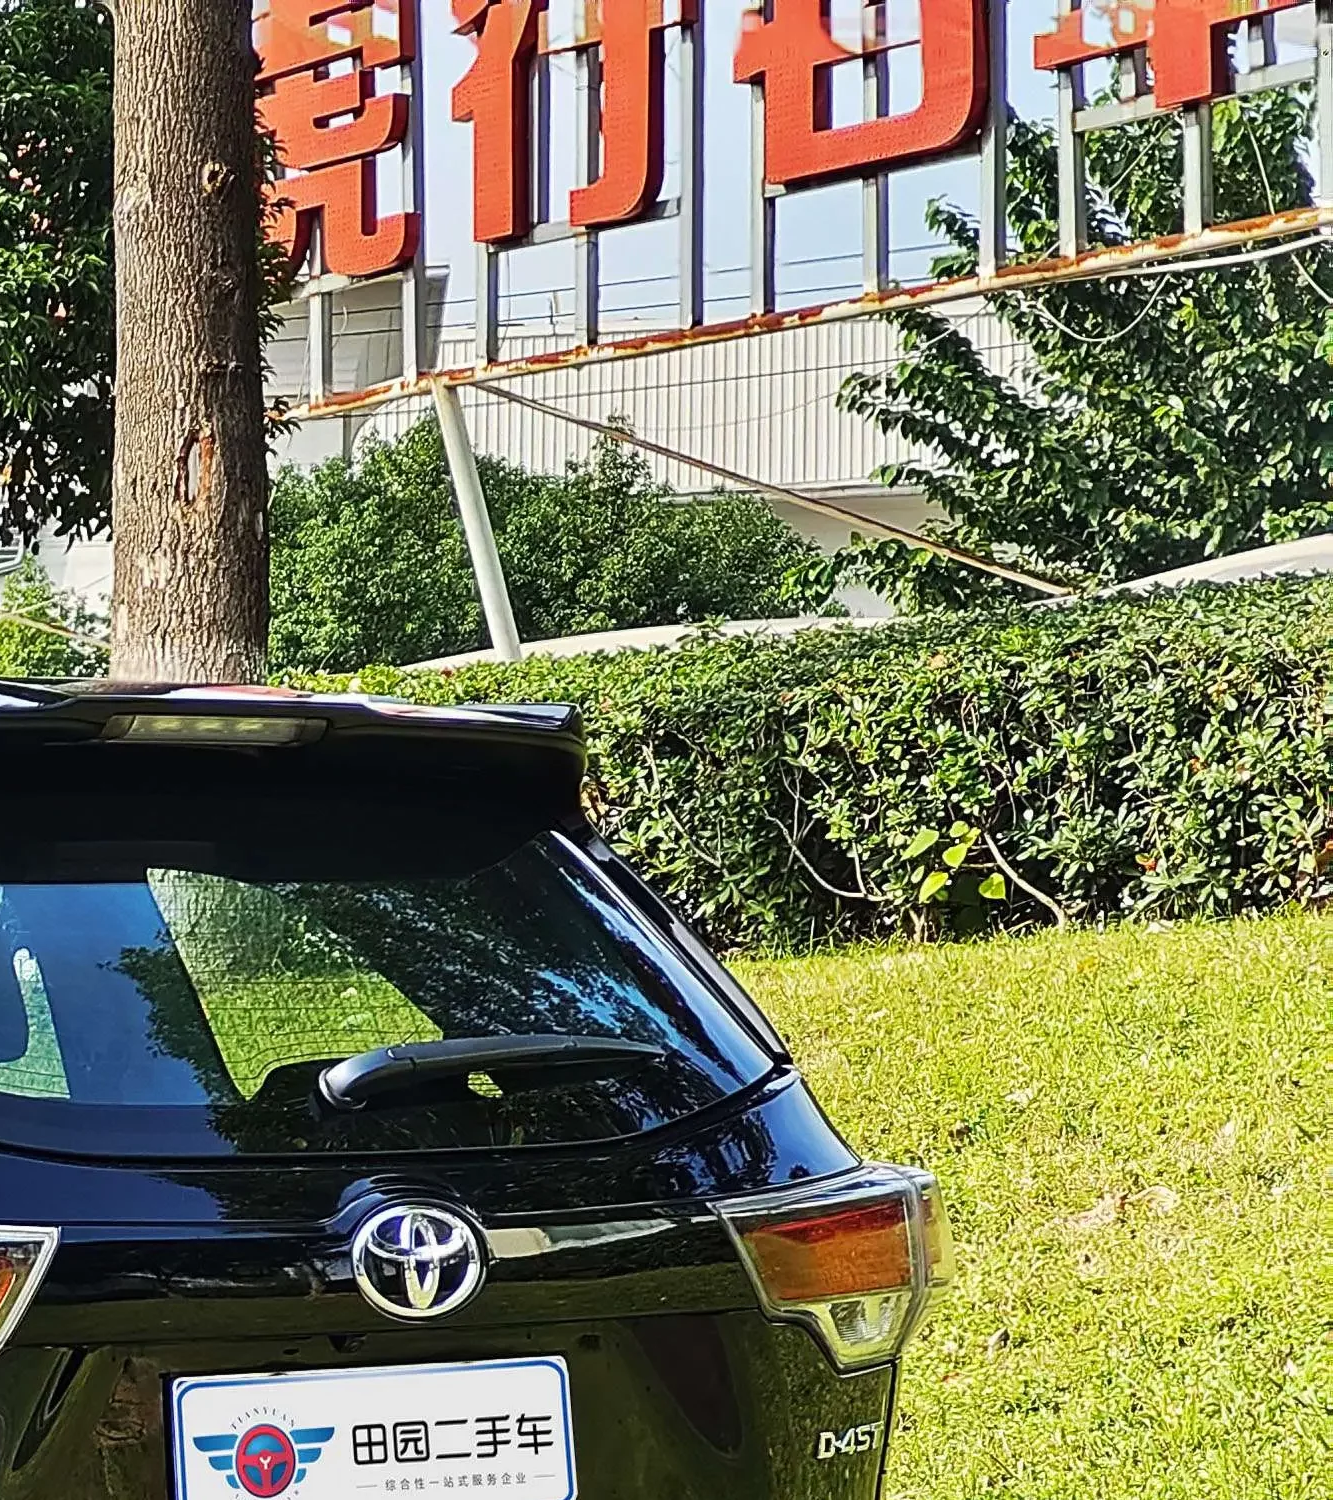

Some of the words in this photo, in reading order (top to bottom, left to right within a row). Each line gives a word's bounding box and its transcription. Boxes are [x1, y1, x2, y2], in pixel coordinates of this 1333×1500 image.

[351, 1413, 555, 1466] 田园二手车
[384, 1472, 528, 1492] 综合性一站式服务企业
